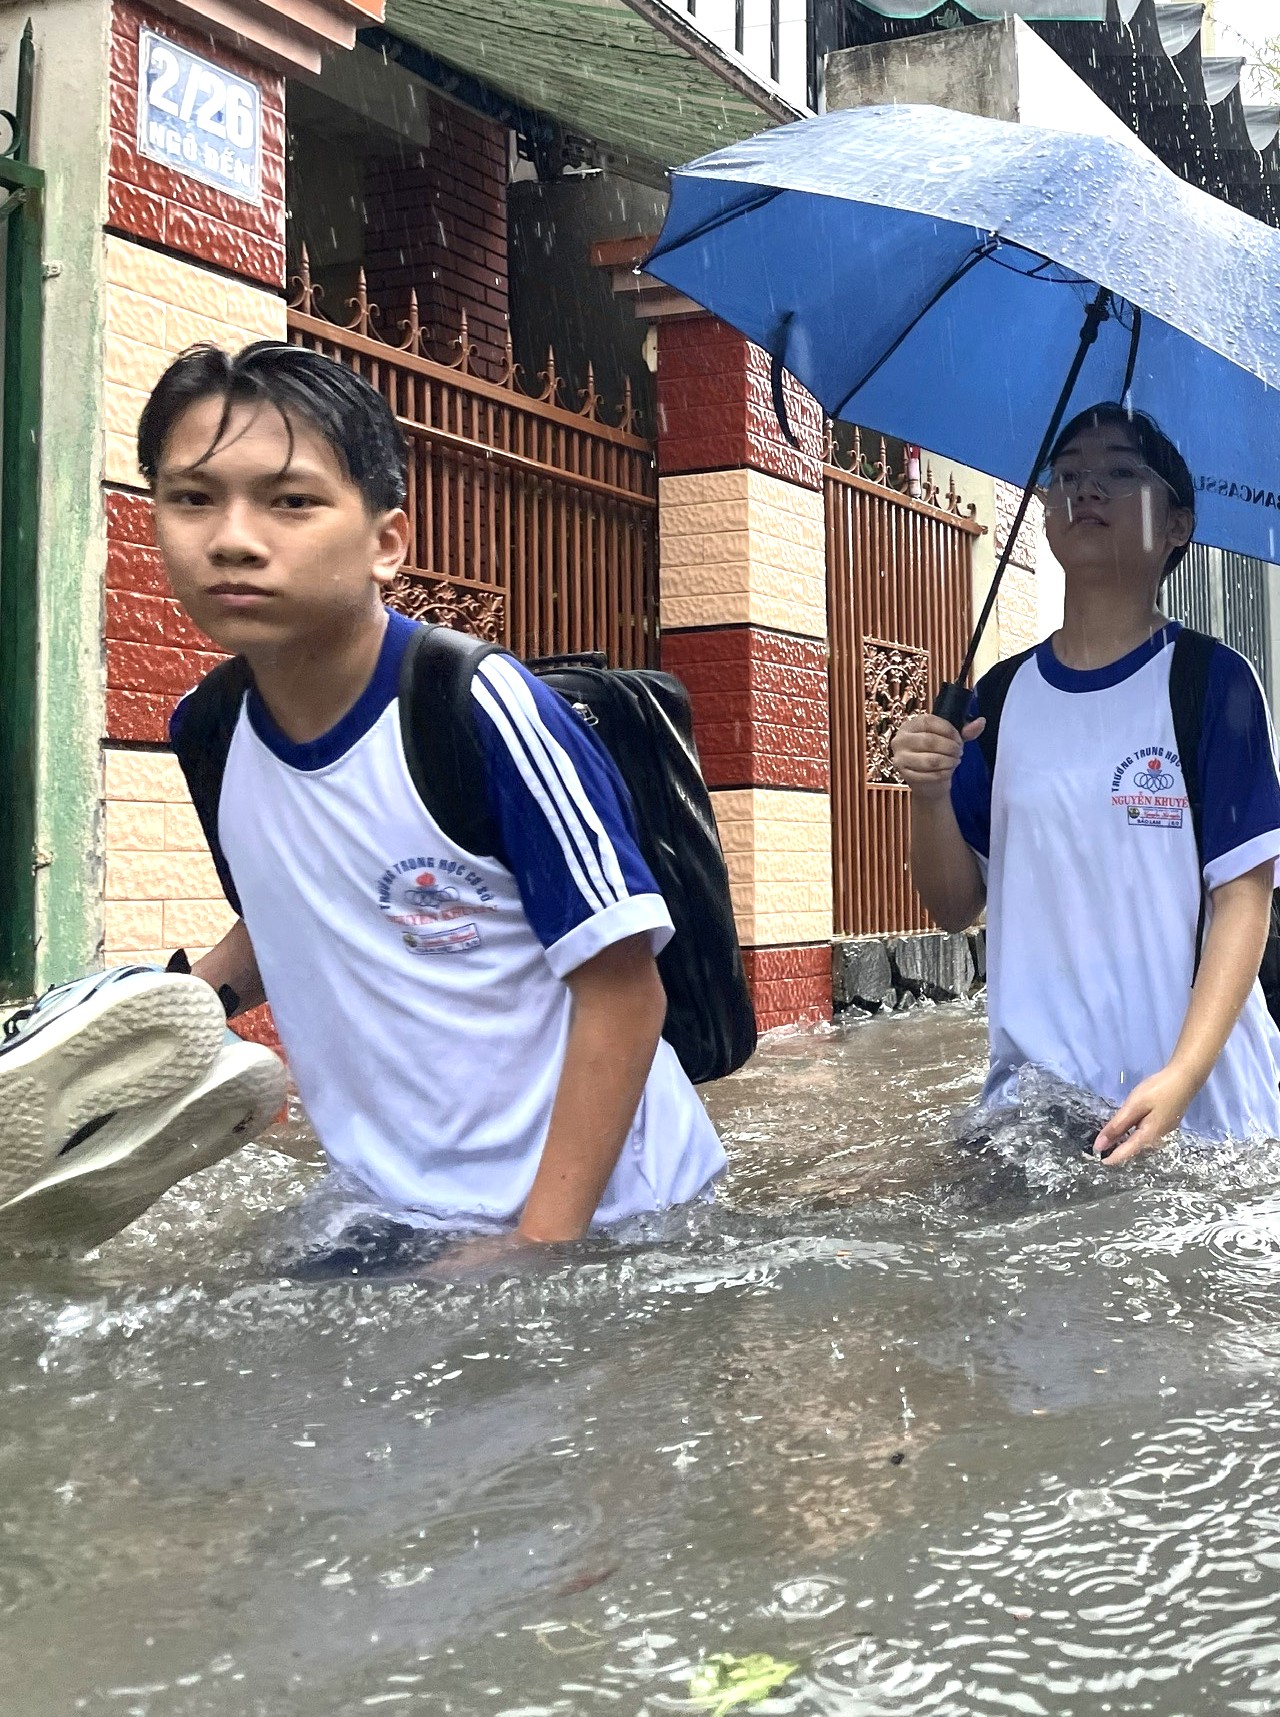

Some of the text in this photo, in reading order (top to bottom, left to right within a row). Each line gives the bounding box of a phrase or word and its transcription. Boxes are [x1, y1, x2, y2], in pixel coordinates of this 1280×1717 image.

[149, 46, 254, 149] 2/26
[149, 121, 198, 162] NGÔ
[1134, 746, 1164, 760] TRUNG
[1164, 751, 1181, 767] HỌC
[1111, 791, 1153, 807] NGUYỄN
